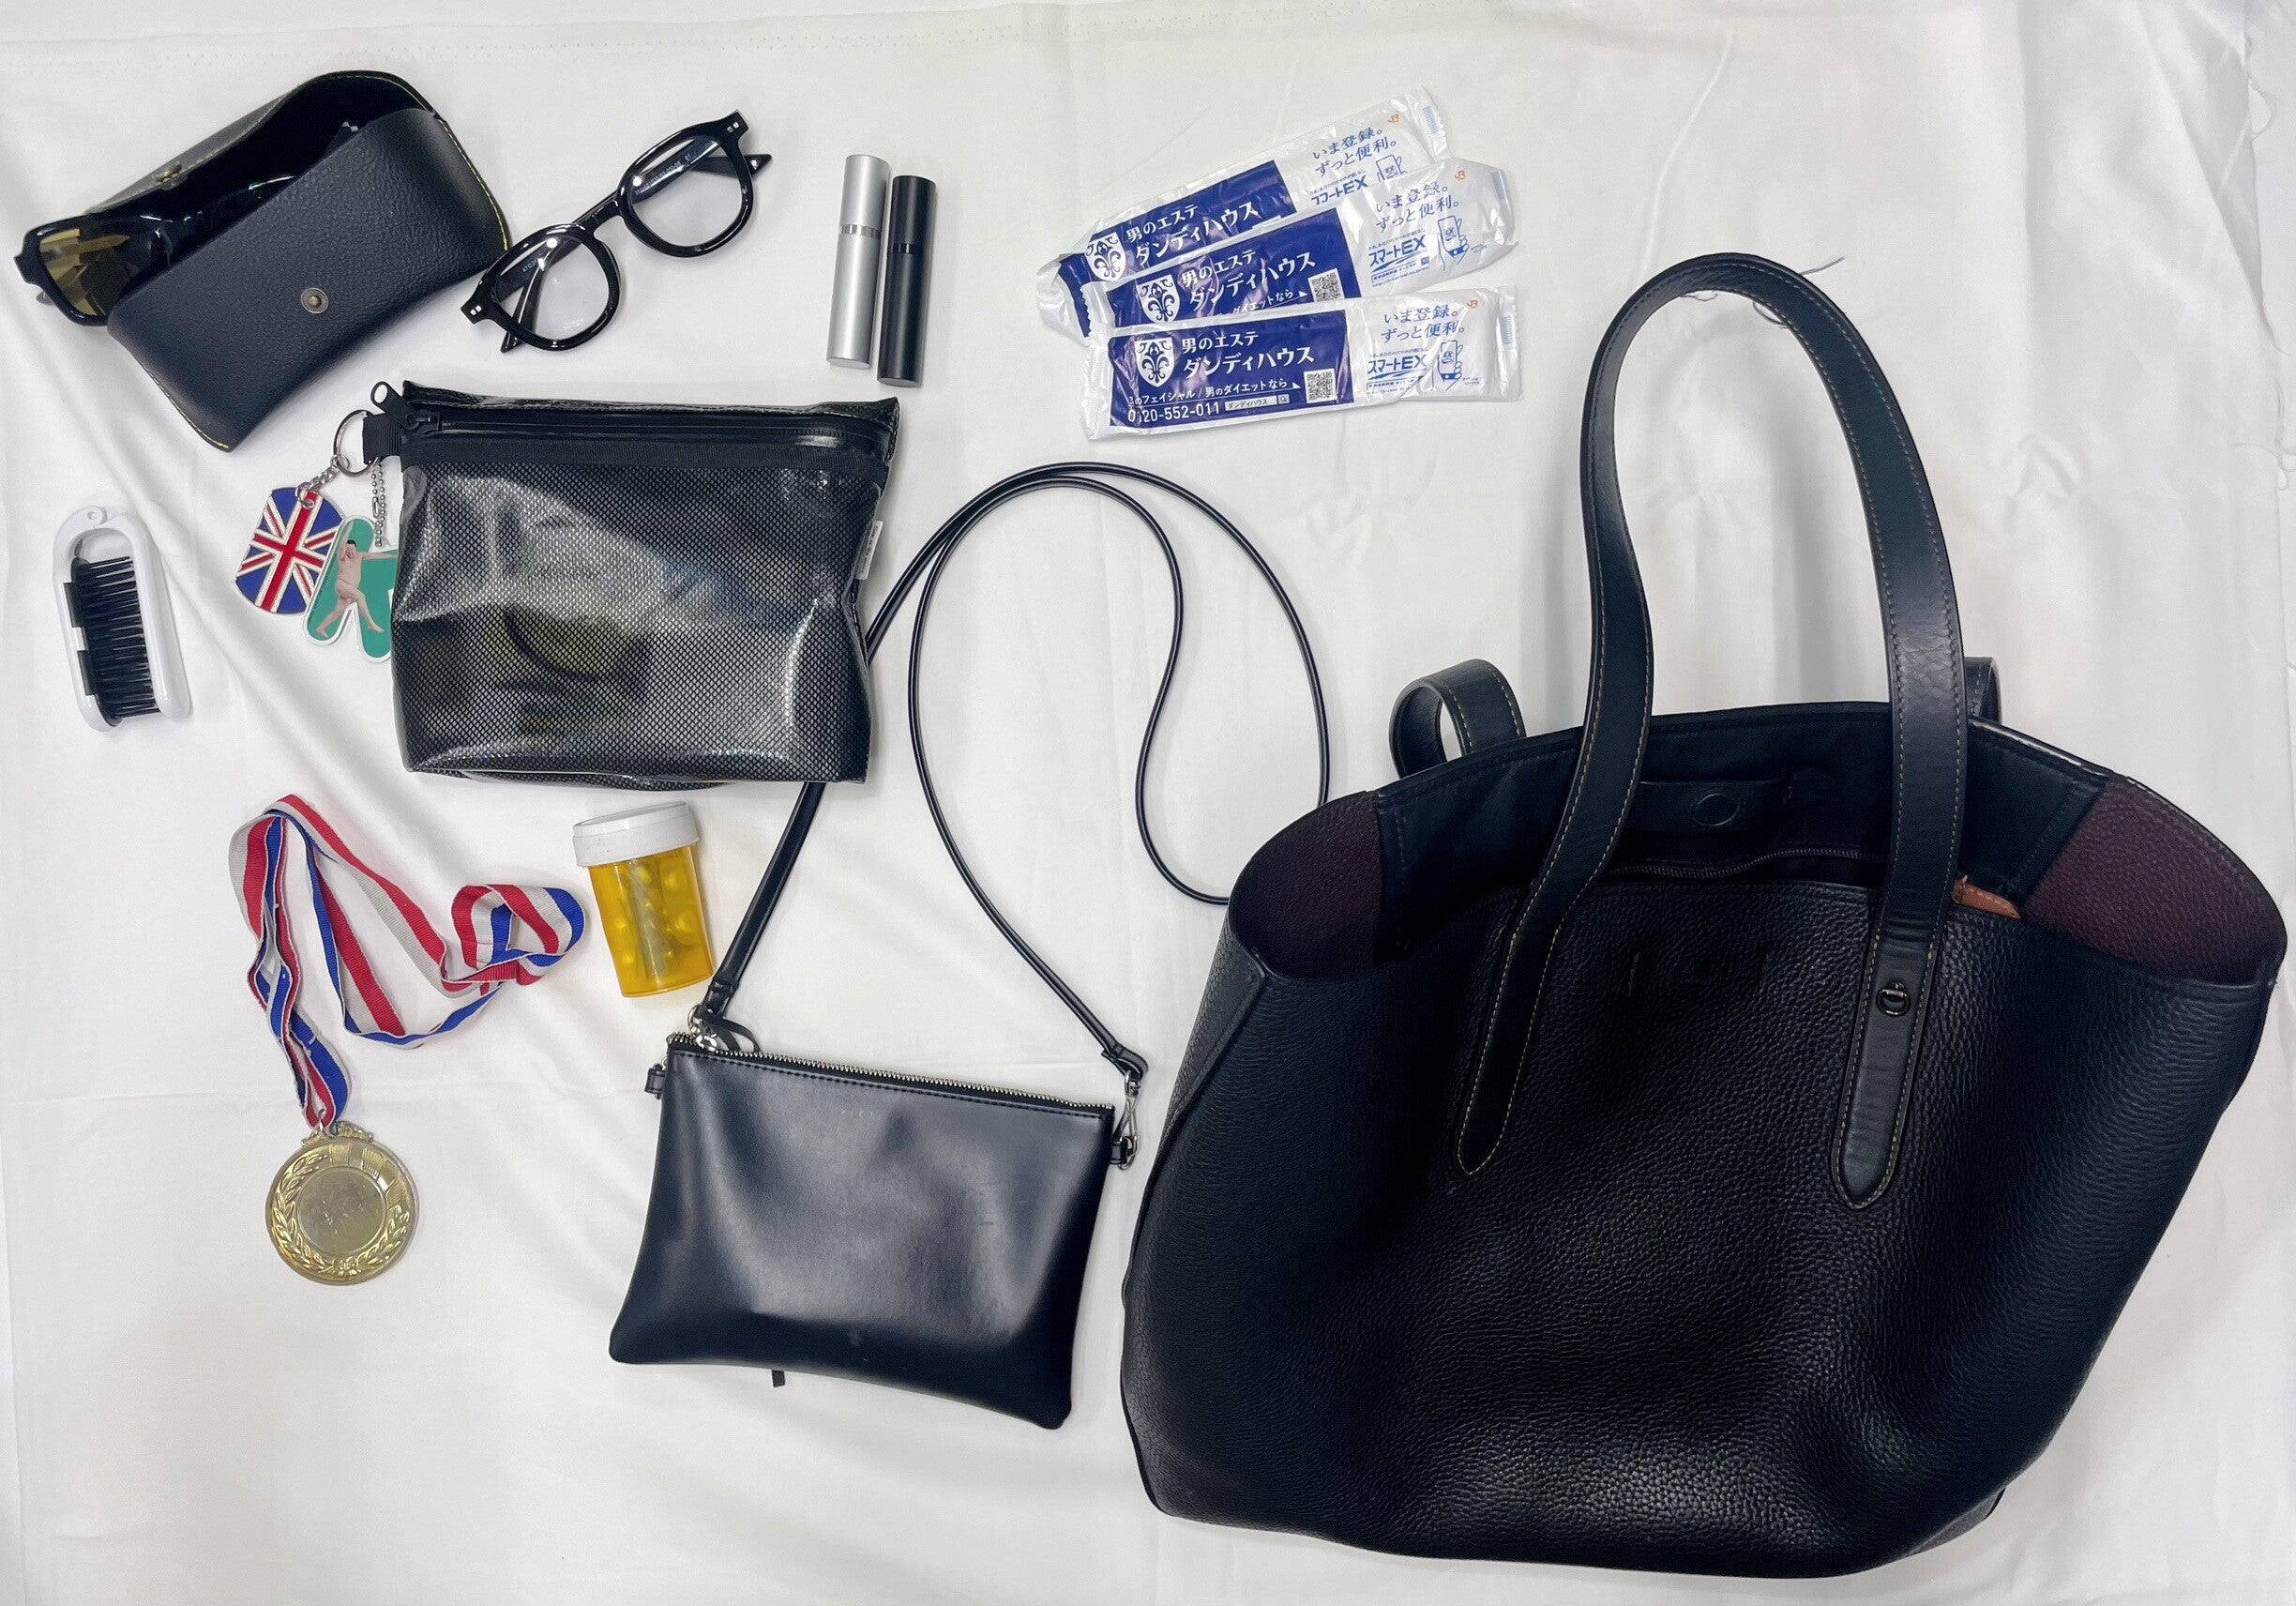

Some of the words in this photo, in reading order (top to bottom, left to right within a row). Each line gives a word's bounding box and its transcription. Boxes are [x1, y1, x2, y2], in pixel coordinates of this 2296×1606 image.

[1313, 127, 1382, 159] いま登録。
[1315, 137, 1397, 177] ずっと便利。
[1376, 181, 1448, 213] いま登録。
[1126, 204, 1199, 243] 男のエステ
[1376, 195, 1459, 233] ずっと便利。
[1134, 201, 1260, 265] ダンディハウス
[1368, 235, 1427, 266] スマートEX
[1181, 249, 1256, 288] 男のエステ
[1189, 251, 1316, 311] ダンディハウス
[1383, 305, 1458, 325] いま登録。
[1181, 331, 1259, 354] 男のエステ
[1382, 321, 1465, 343] ずっと便利。
[1183, 345, 1315, 379] ダンディハウス
[1367, 354, 1427, 374] スマートEX
